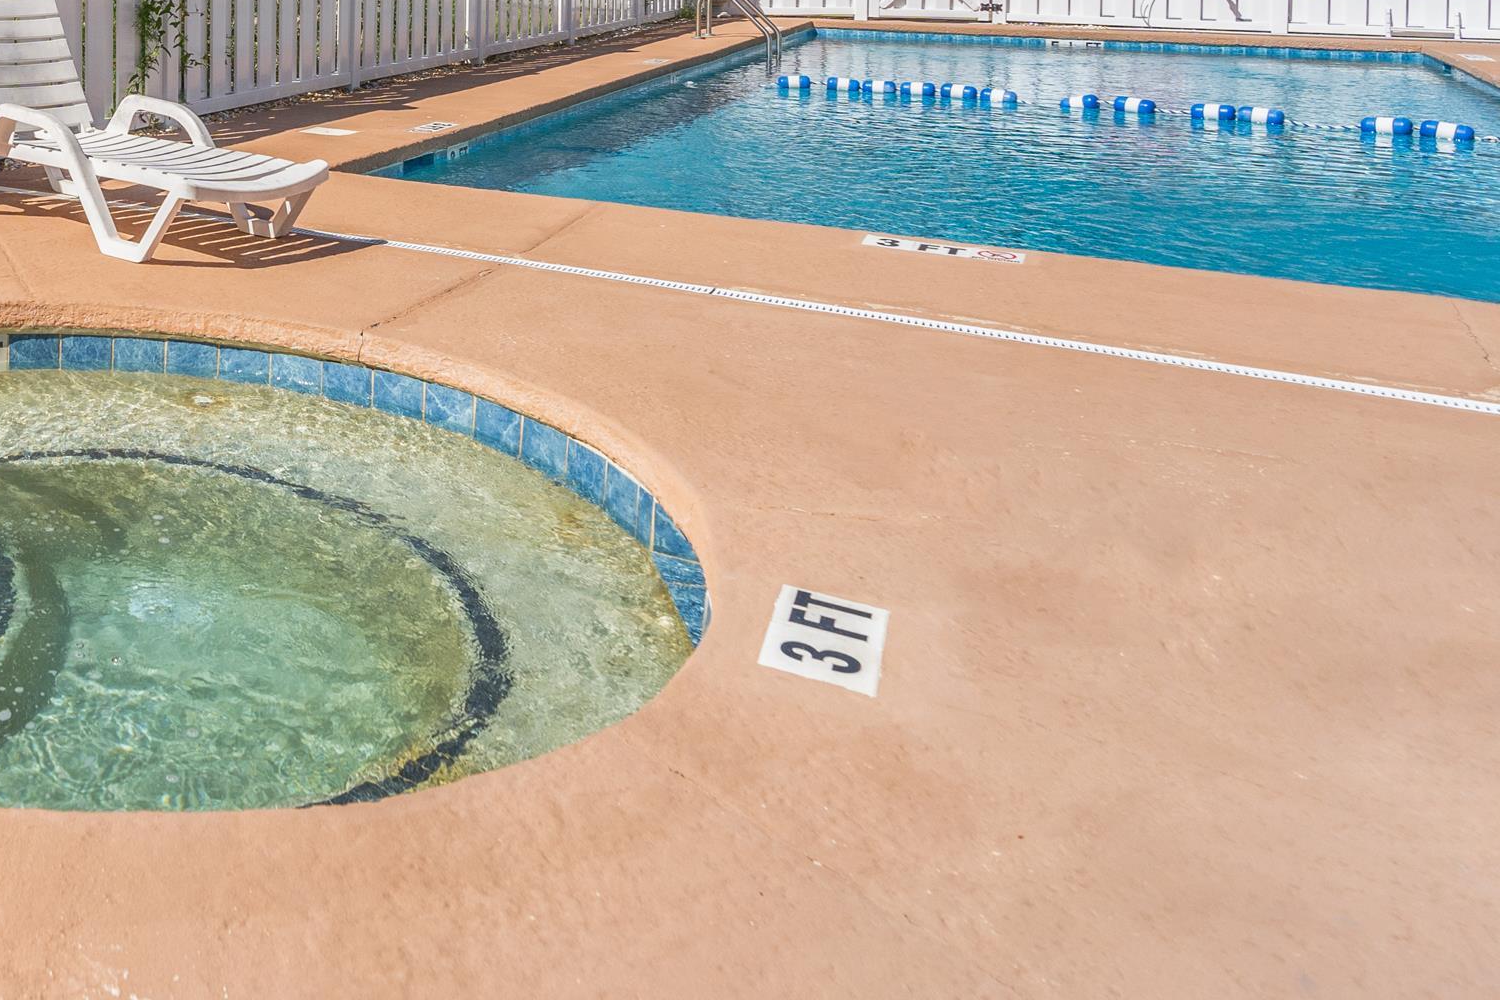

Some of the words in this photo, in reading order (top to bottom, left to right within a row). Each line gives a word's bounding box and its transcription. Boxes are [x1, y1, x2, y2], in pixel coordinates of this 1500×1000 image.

[876, 238, 900, 247] 3
[917, 243, 967, 255] FT
[788, 589, 873, 642] FT
[780, 641, 862, 674] 3
